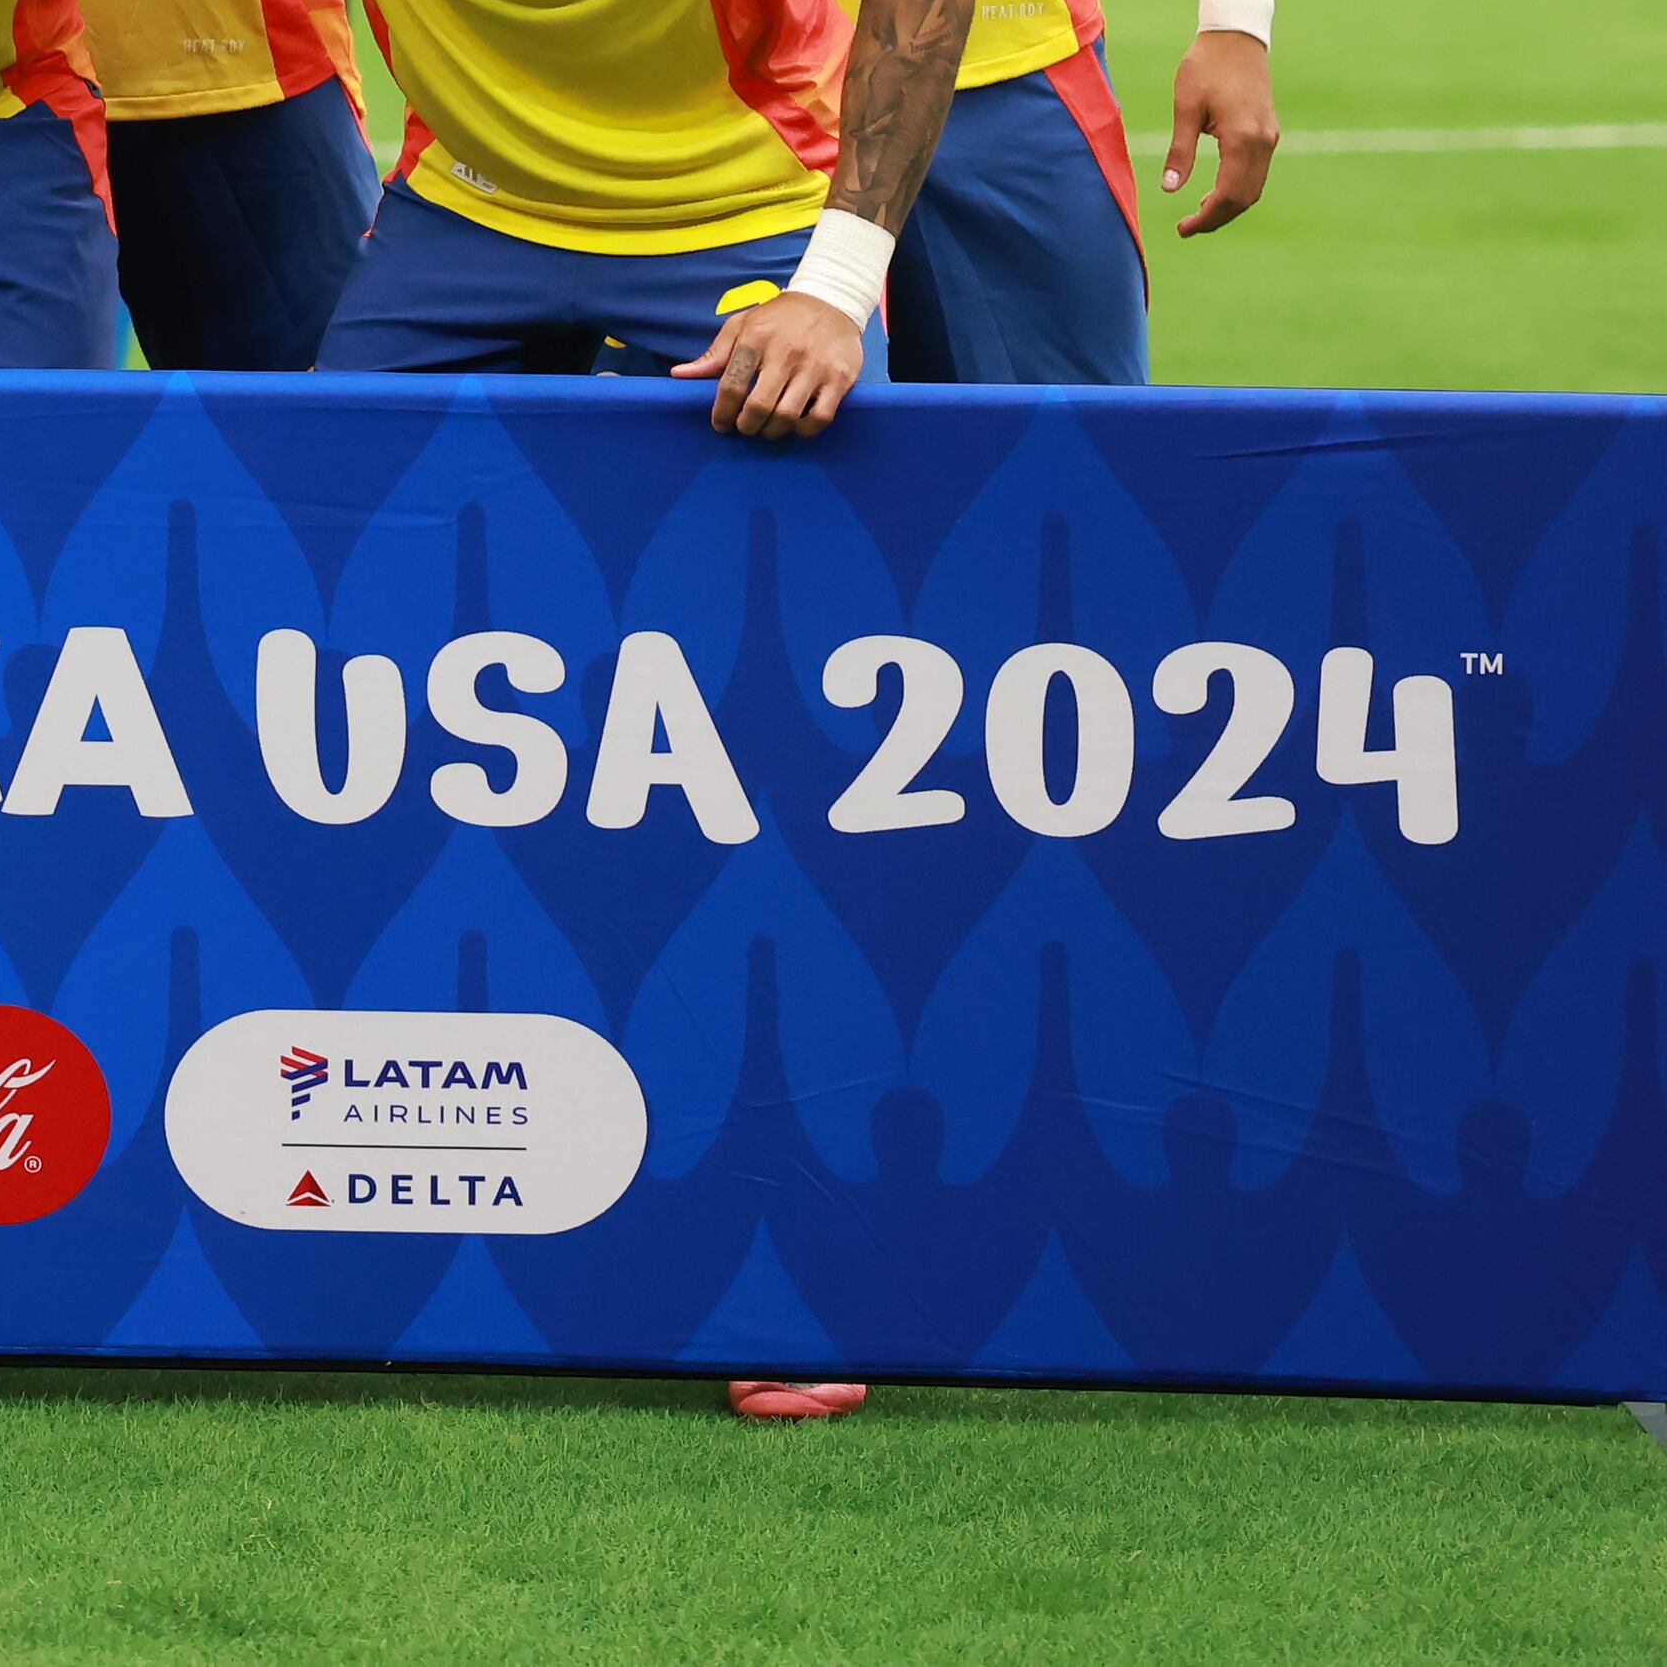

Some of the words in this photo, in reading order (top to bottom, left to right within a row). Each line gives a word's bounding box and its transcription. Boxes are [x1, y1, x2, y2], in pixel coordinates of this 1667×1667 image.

[256, 628, 760, 845] USA
[821, 634, 1459, 845] 2024
[344, 1059, 528, 1090] LATAM
[343, 1104, 528, 1125] AIRLINES
[348, 1173, 524, 1207] DELTA
